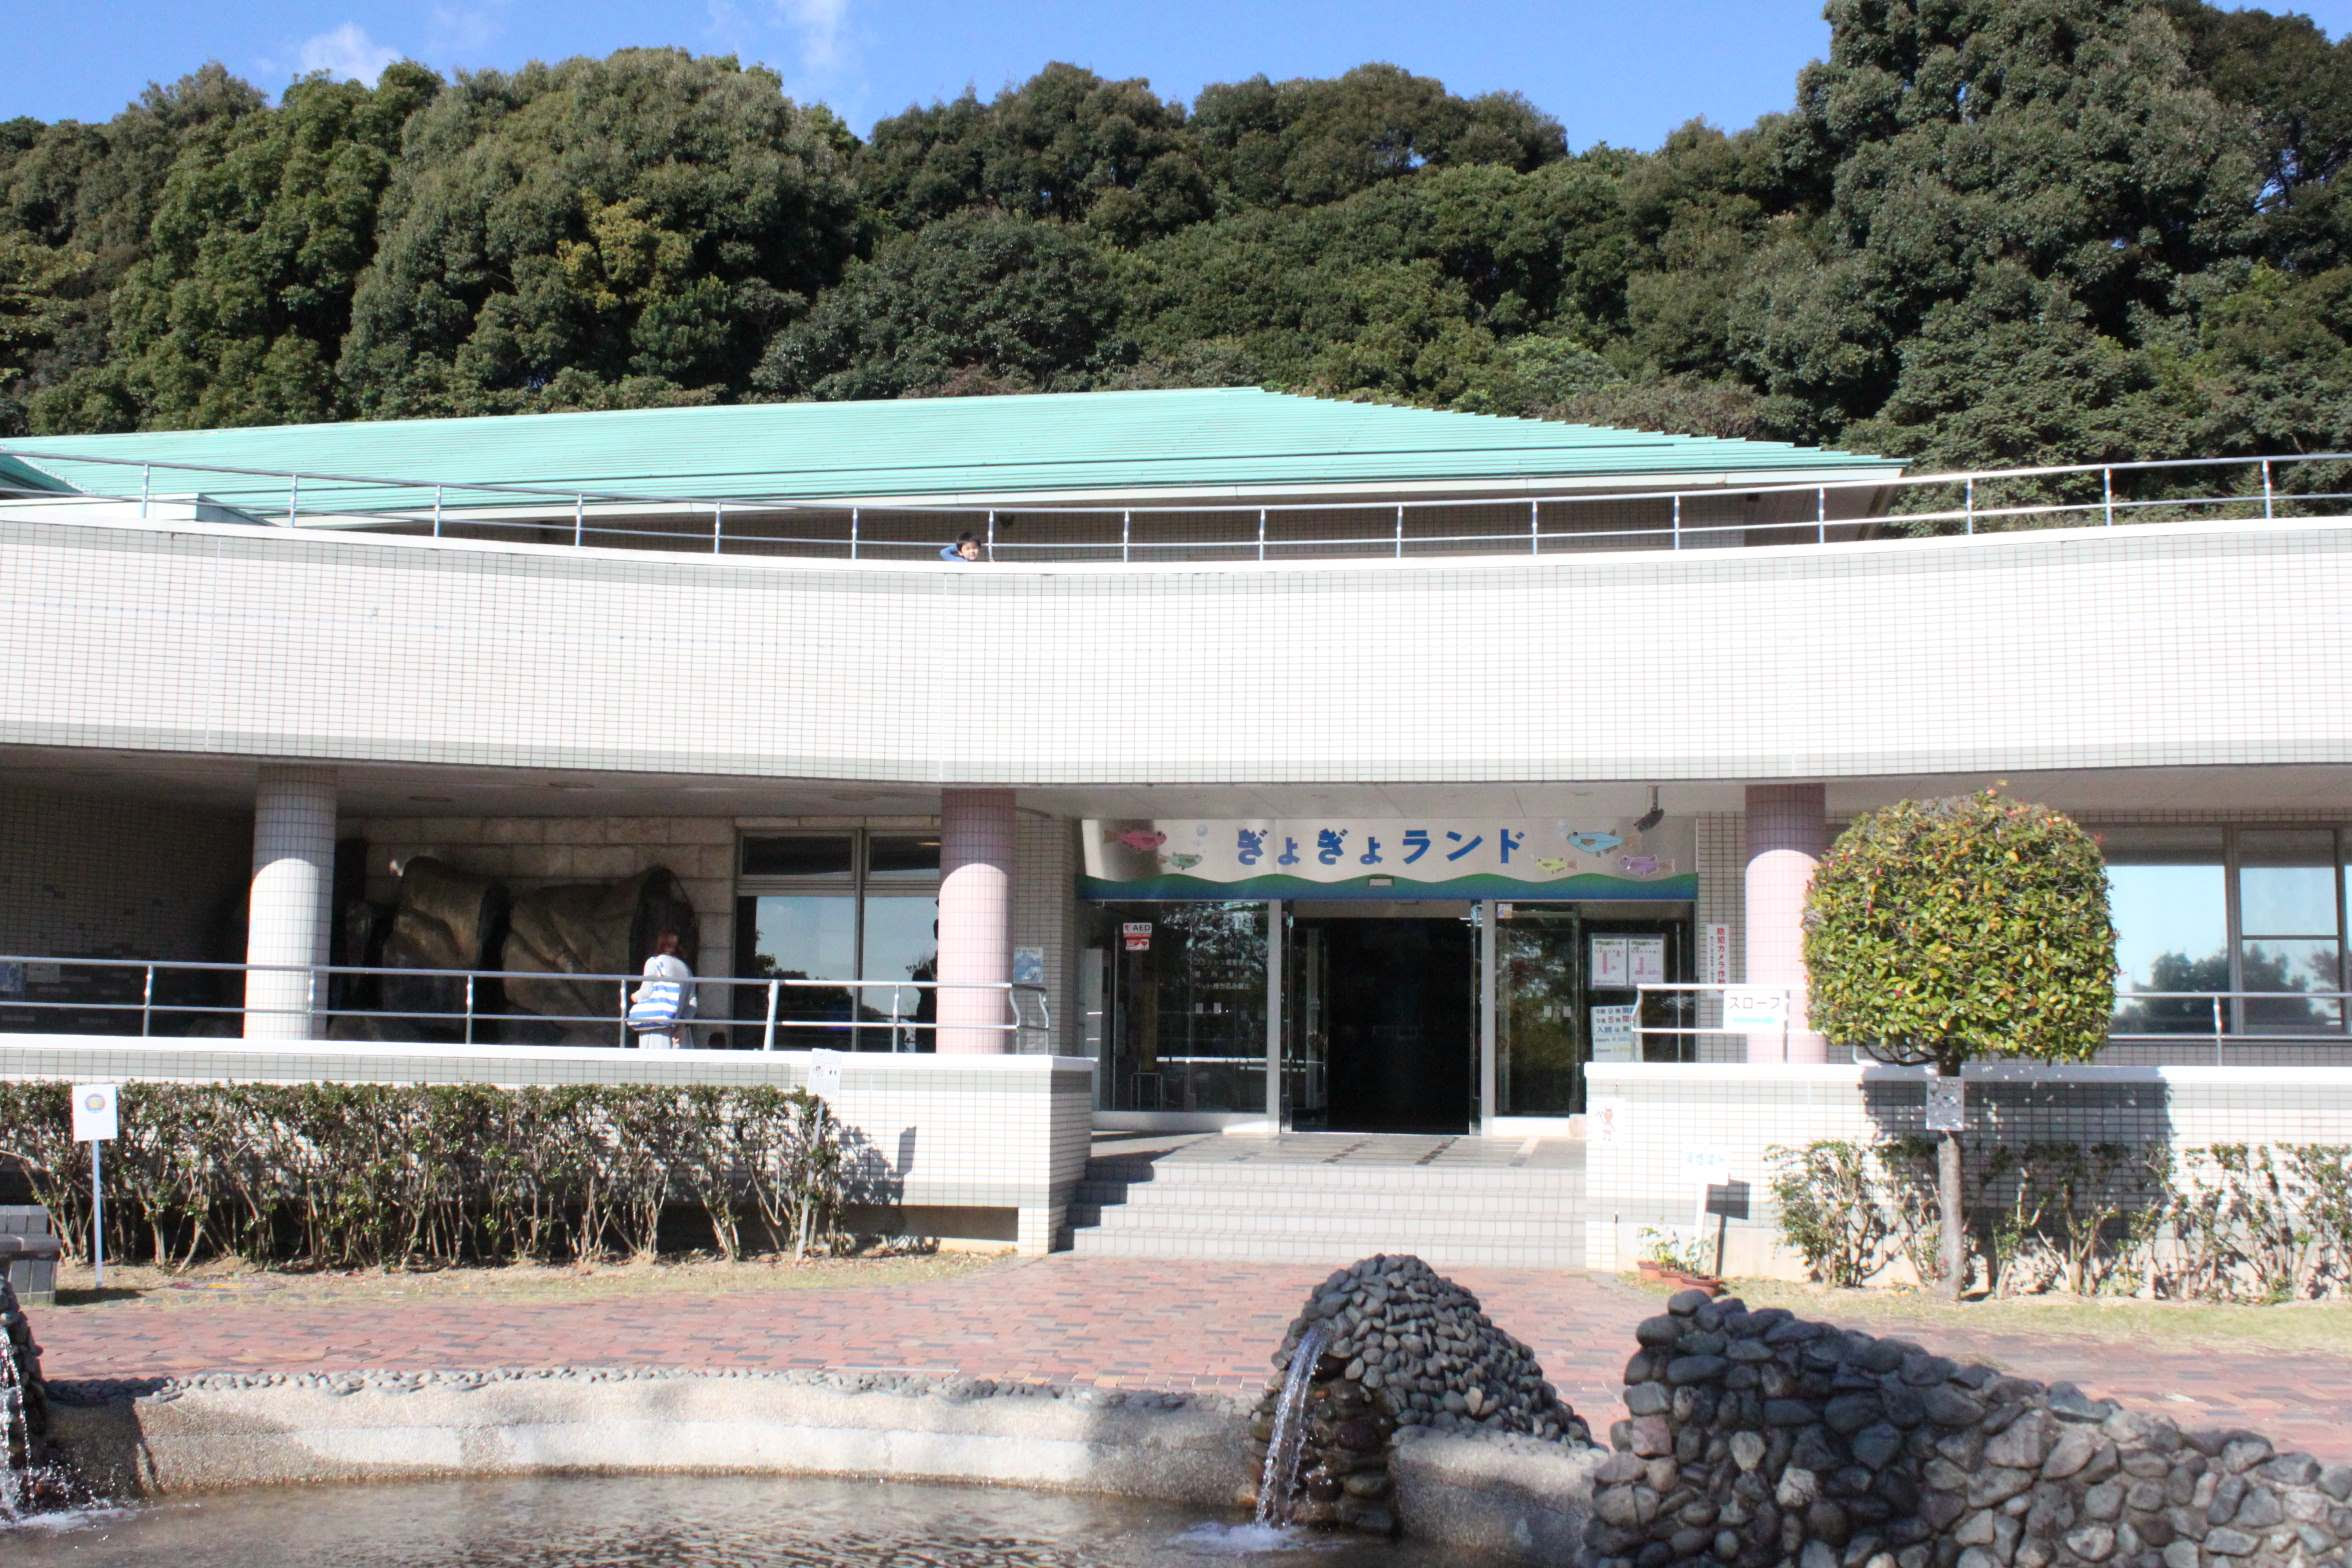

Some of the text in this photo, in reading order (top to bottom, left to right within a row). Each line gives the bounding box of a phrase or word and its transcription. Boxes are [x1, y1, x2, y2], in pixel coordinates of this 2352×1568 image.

[1237, 828, 1525, 866] ぎょぎょランド
[1132, 924, 1152, 932] AED
